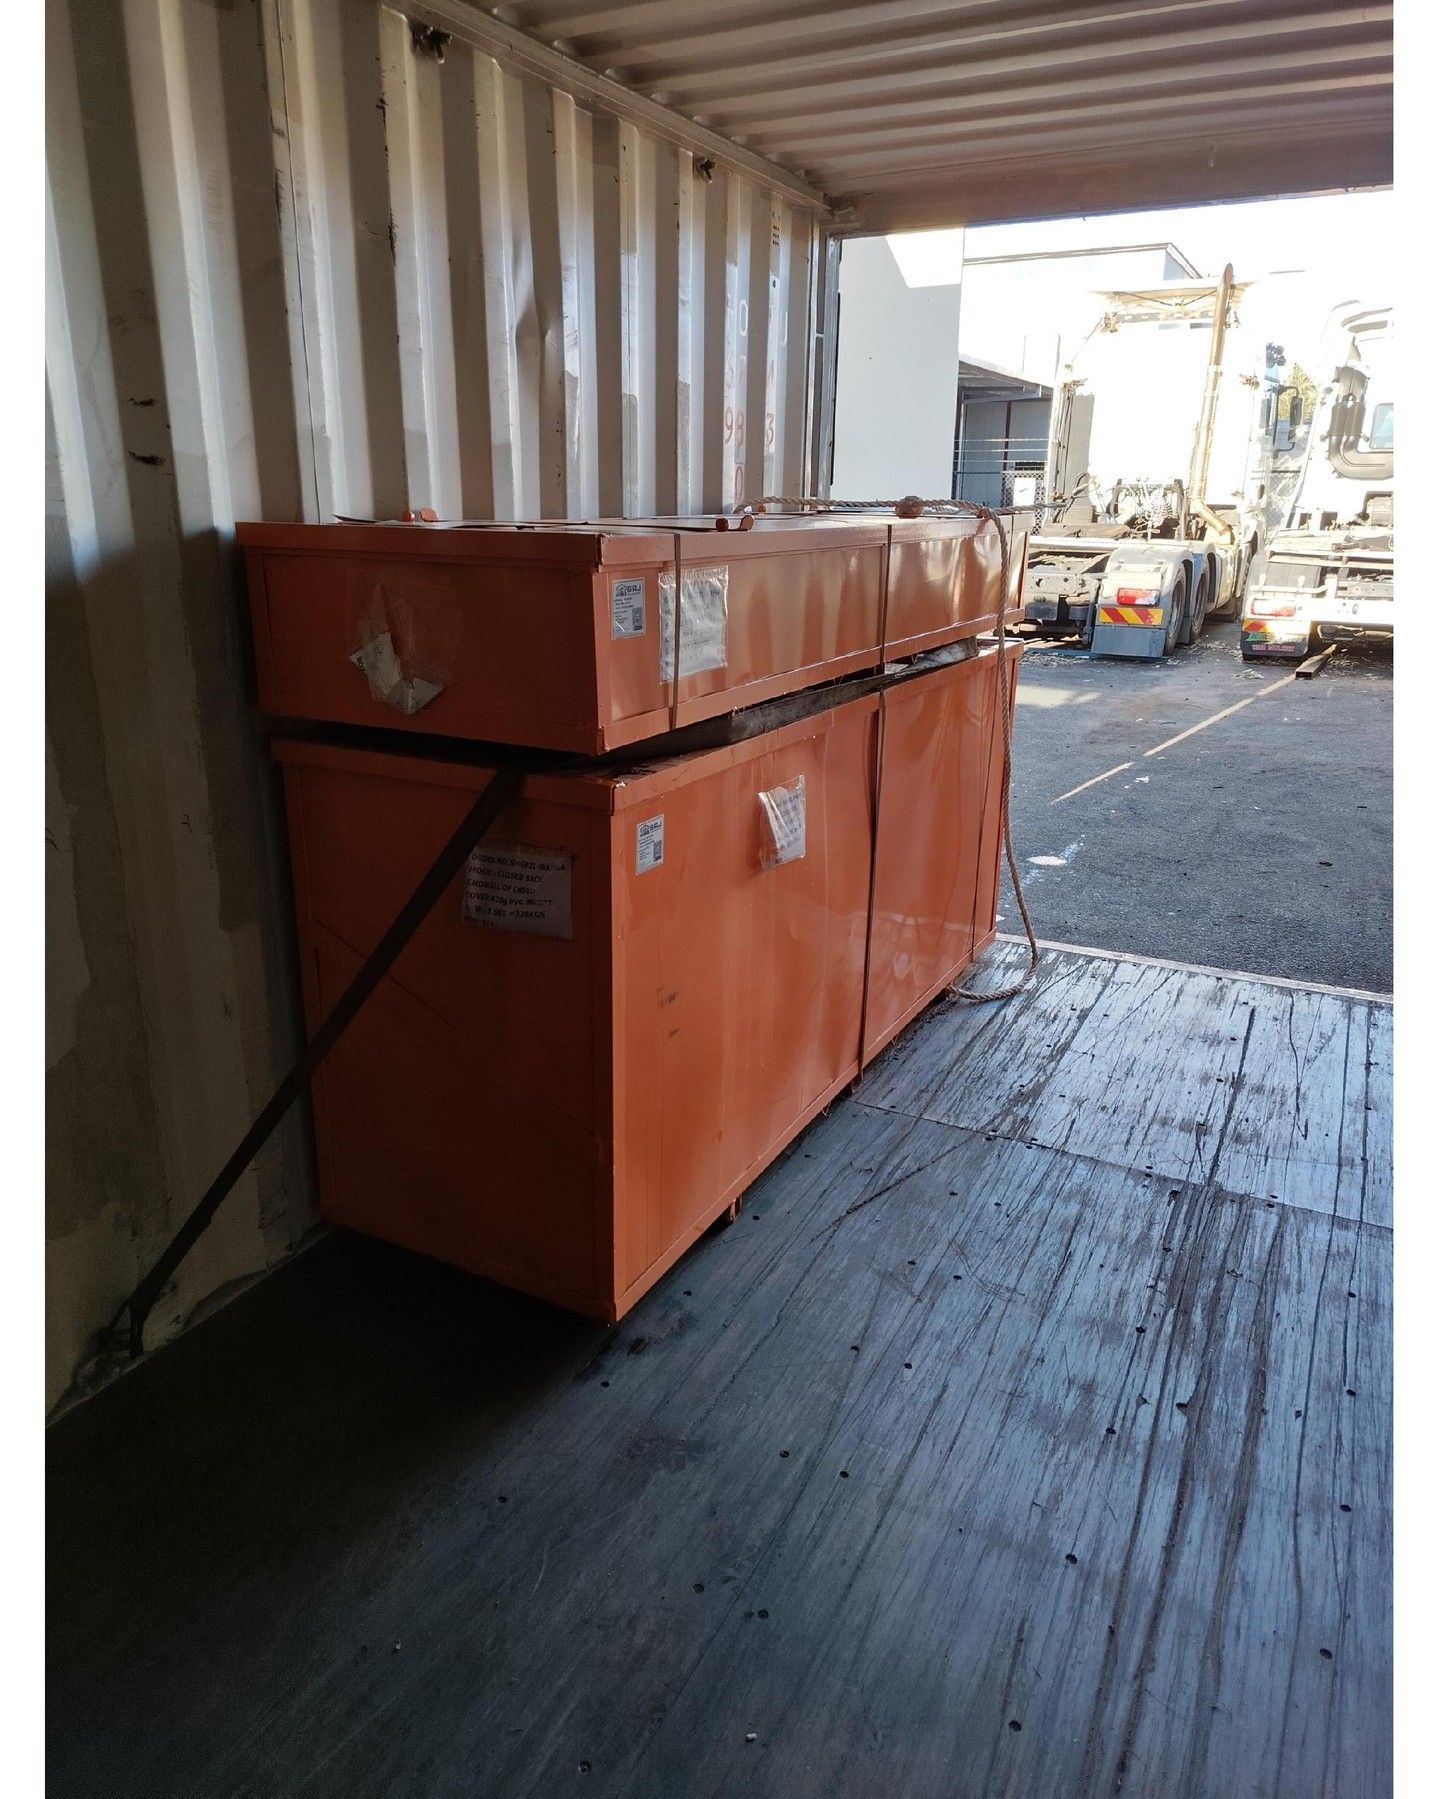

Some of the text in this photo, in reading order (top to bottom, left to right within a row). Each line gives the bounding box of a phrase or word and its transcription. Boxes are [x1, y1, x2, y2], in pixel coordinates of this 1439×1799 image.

[471, 853, 496, 864] ORDER
[497, 870, 524, 881] CLOSED
[502, 883, 511, 892] OF
[508, 898, 523, 906] PVC
[493, 907, 506, 917] SET
